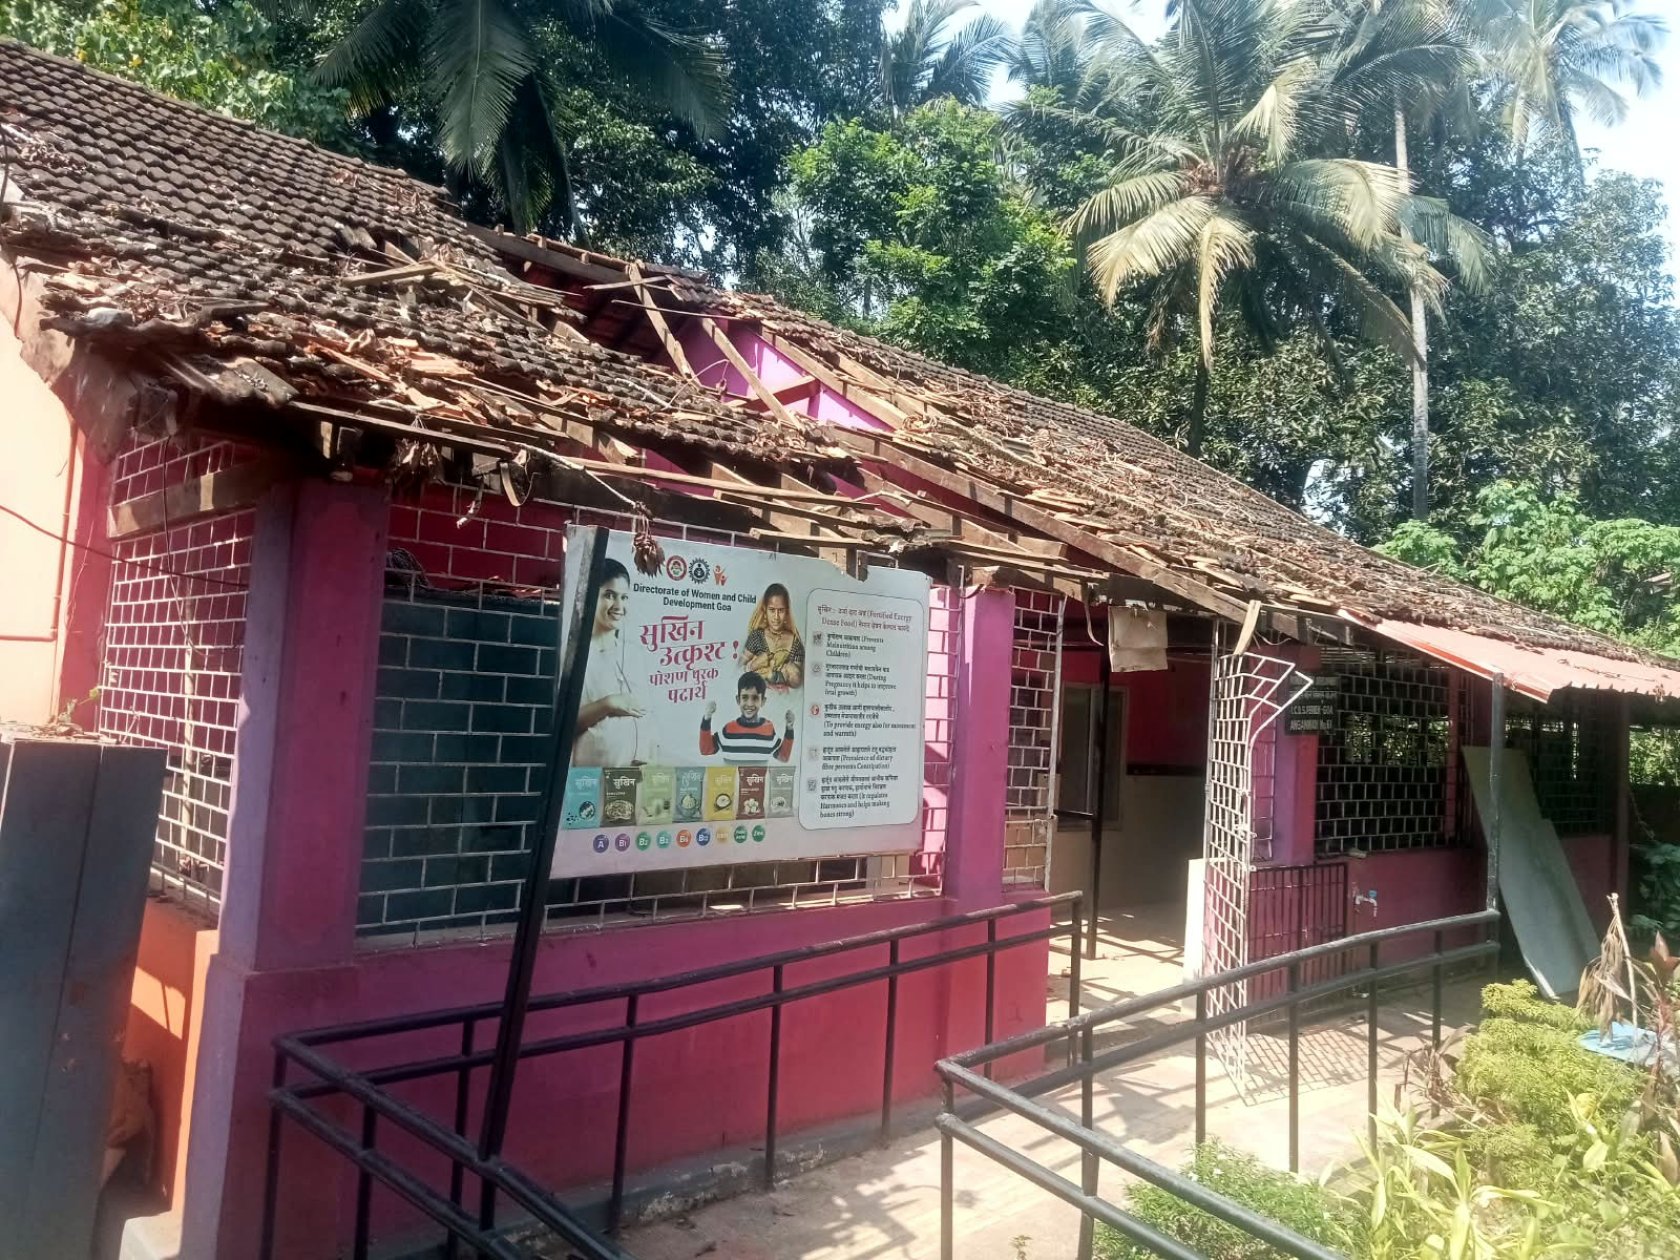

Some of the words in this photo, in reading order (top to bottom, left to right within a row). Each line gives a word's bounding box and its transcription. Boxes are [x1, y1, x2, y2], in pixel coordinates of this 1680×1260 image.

[633, 583, 679, 596] Directorate
[681, 588, 689, 597] of
[692, 590, 720, 600] Women
[722, 593, 736, 602] and
[738, 594, 756, 604] Child
[663, 597, 715, 611] Development
[717, 603, 732, 611] Goa
[639, 615, 705, 652] सुखिन
[612, 776, 636, 790] सुखिन
[746, 774, 764, 786] सुखिन
[597, 840, 604, 848] A
